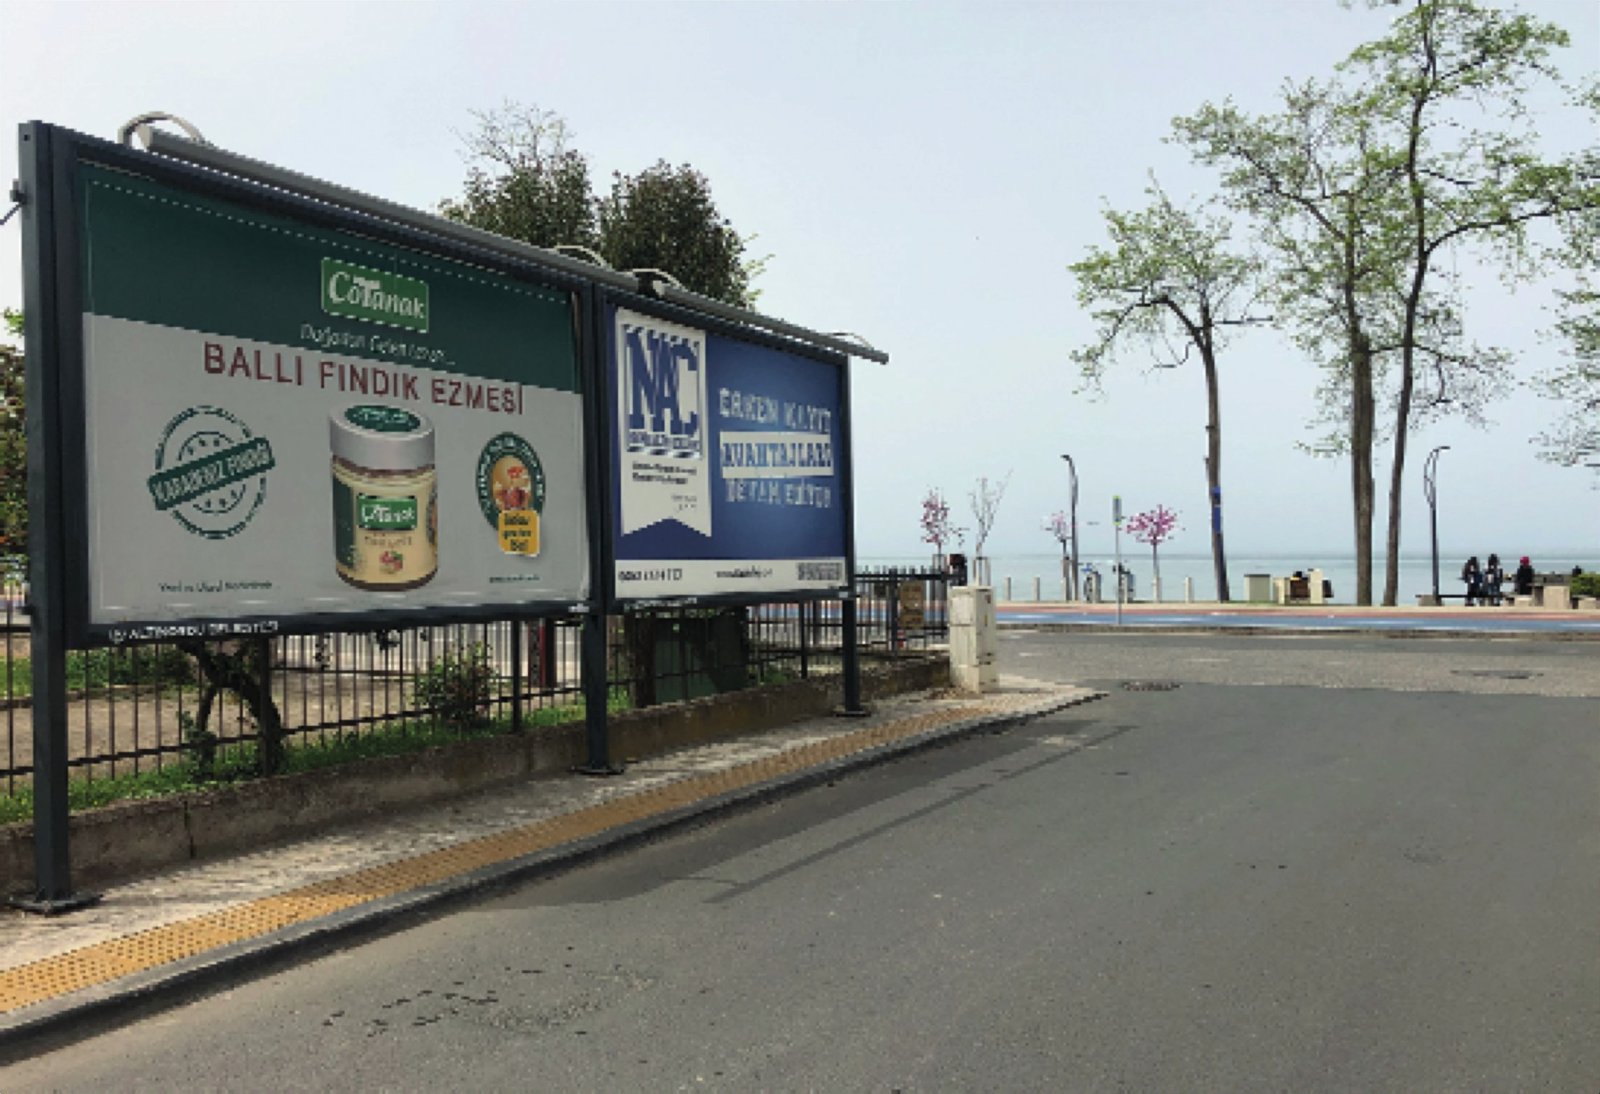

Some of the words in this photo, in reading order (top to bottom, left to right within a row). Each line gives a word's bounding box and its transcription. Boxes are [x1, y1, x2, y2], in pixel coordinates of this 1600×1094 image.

[203, 341, 304, 386] BALLI
[319, 361, 420, 401] FINDIK
[625, 326, 699, 440] NAC
